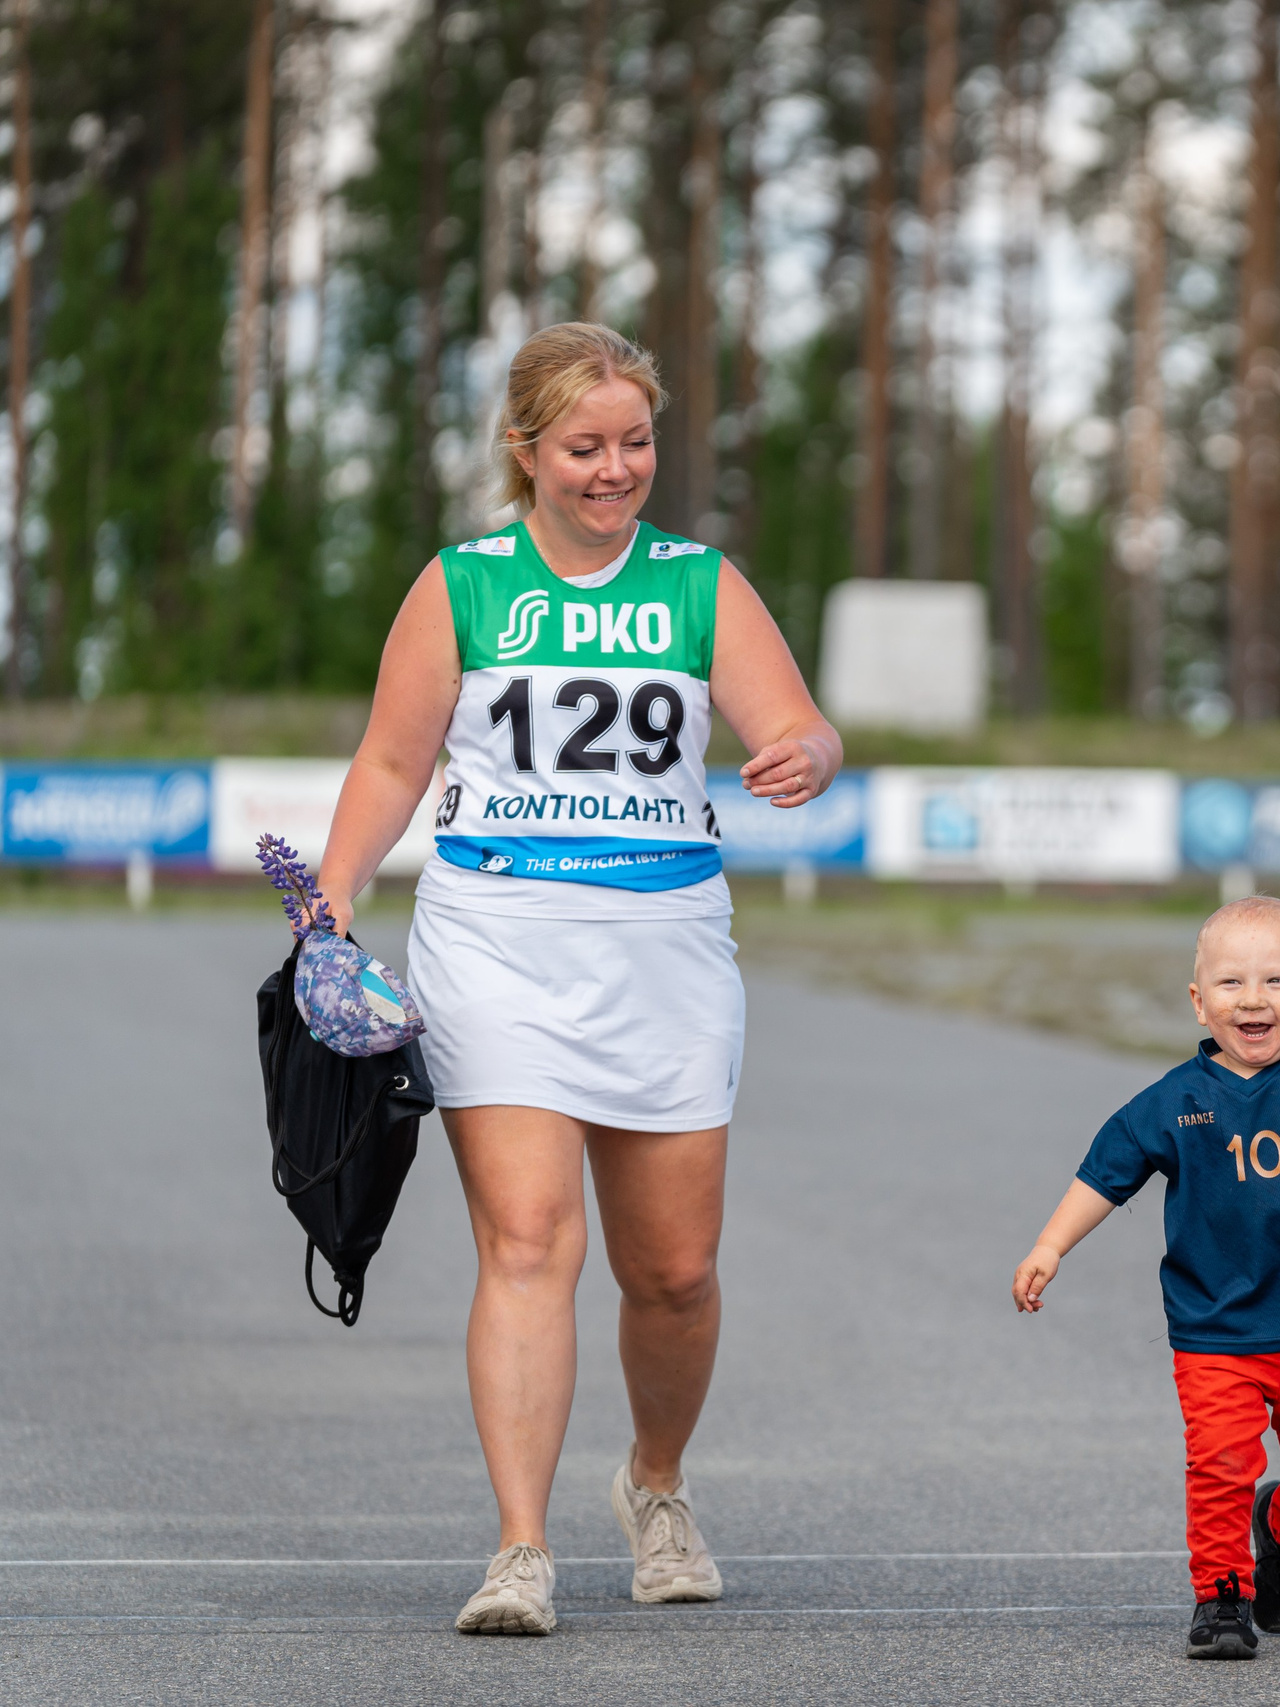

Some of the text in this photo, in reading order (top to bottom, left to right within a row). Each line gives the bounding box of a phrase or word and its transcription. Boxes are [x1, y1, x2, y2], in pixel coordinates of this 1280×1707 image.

[563, 602, 672, 654] PKO
[487, 675, 687, 778] 129
[482, 794, 685, 824] KONTIOLAHTI
[525, 857, 556, 871] THE
[559, 854, 634, 871] OFFICIAL
[1177, 1111, 1215, 1128] FRANCE
